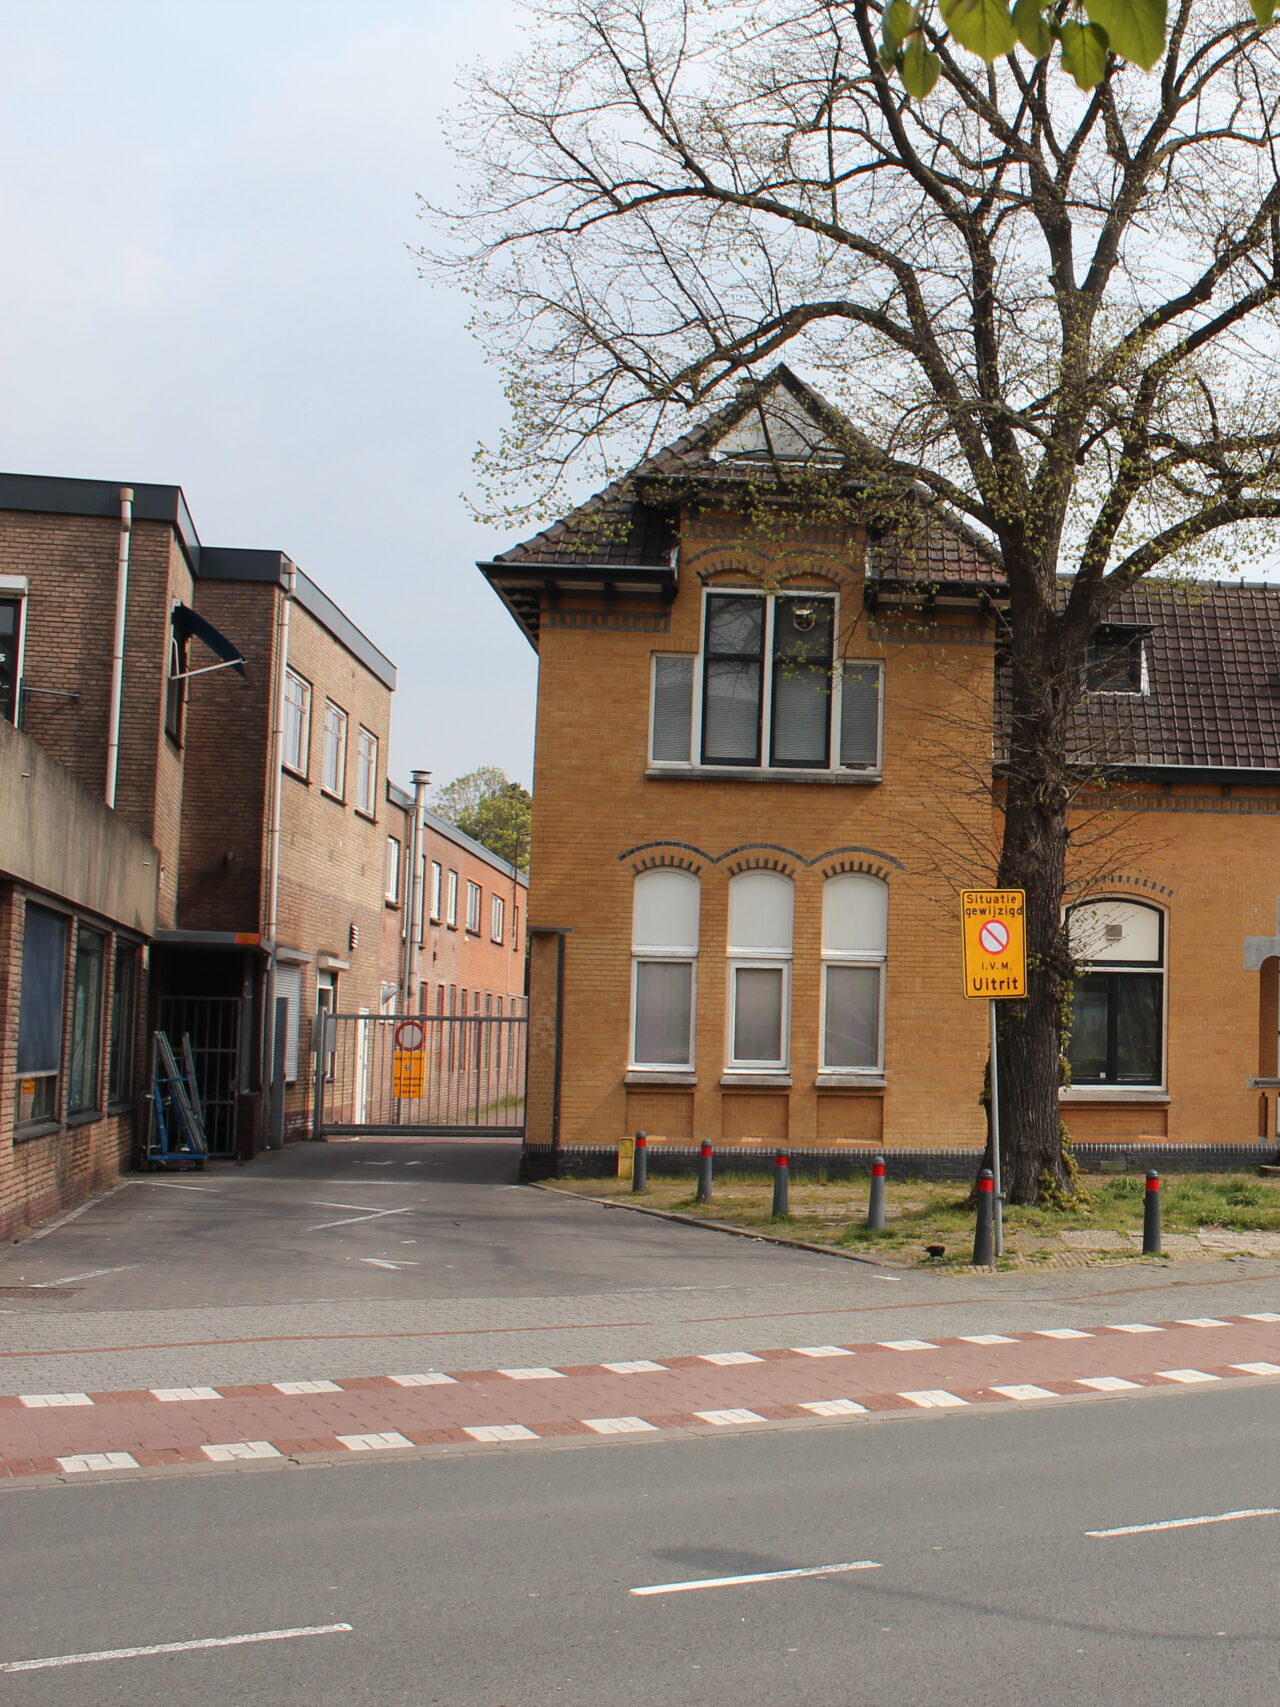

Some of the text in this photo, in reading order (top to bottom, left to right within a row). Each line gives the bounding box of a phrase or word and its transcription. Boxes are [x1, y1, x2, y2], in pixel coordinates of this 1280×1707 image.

[966, 894, 1017, 904] Situatie
[965, 905, 1023, 918] gewijzigd
[973, 977, 1018, 990] Uitrit
